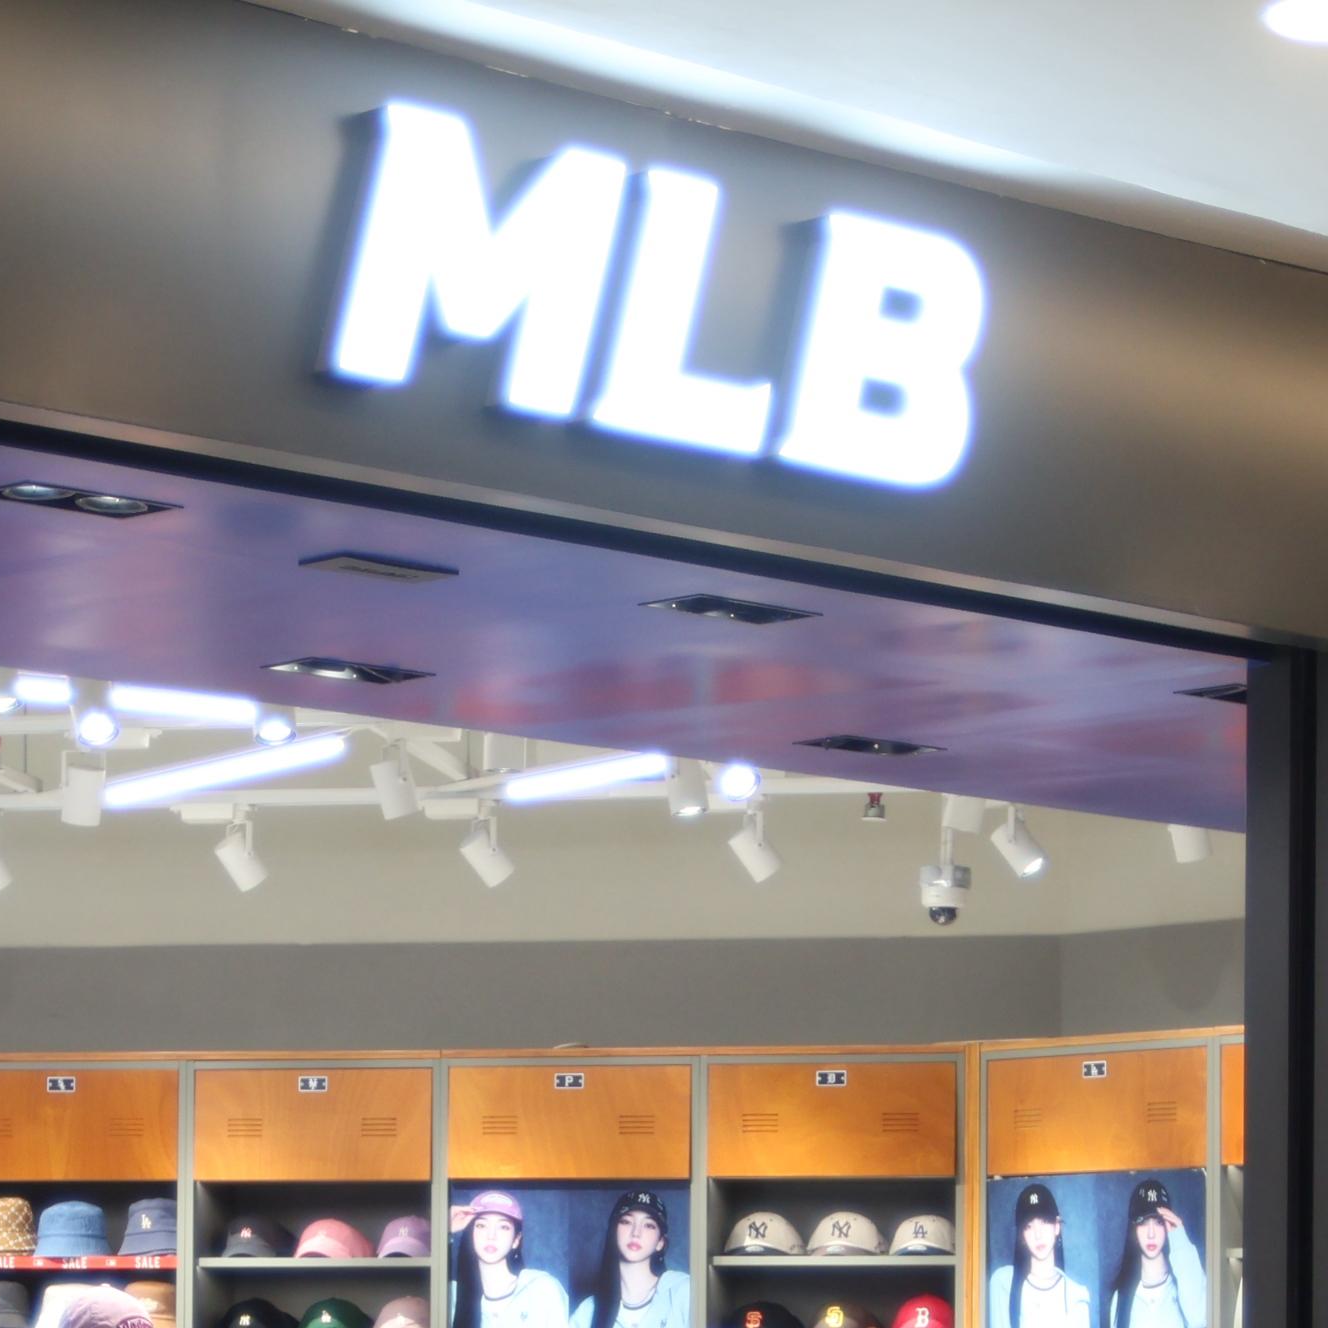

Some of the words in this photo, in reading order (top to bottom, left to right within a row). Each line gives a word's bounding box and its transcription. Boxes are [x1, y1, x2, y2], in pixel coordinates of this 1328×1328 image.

[328, 96, 988, 491] MLB
[747, 1220, 768, 1239] NY
[830, 1219, 852, 1239] NY
[912, 1221, 928, 1239] LA
[62, 1256, 87, 1269] SALE
[135, 1256, 160, 1269] SALE
[915, 1306, 930, 1328] B
